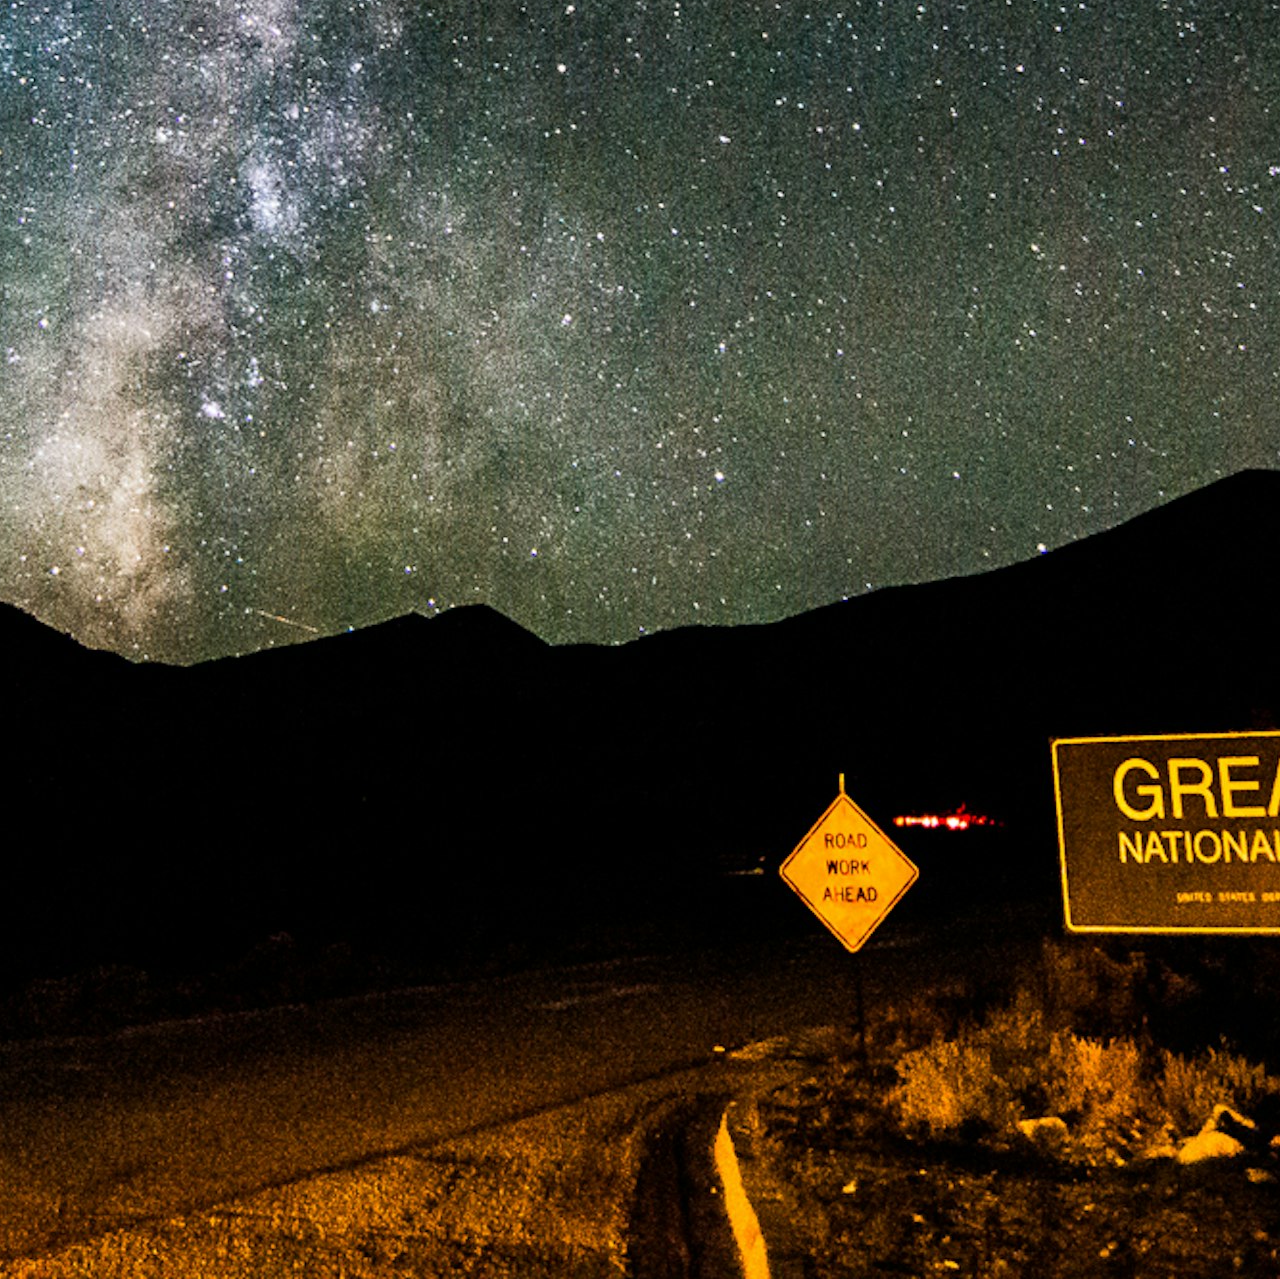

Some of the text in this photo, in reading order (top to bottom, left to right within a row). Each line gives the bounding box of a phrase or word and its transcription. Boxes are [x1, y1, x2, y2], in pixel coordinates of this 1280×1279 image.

[824, 833, 868, 849] ROAD
[826, 859, 871, 875] WORK
[822, 886, 878, 903] AHEAD
